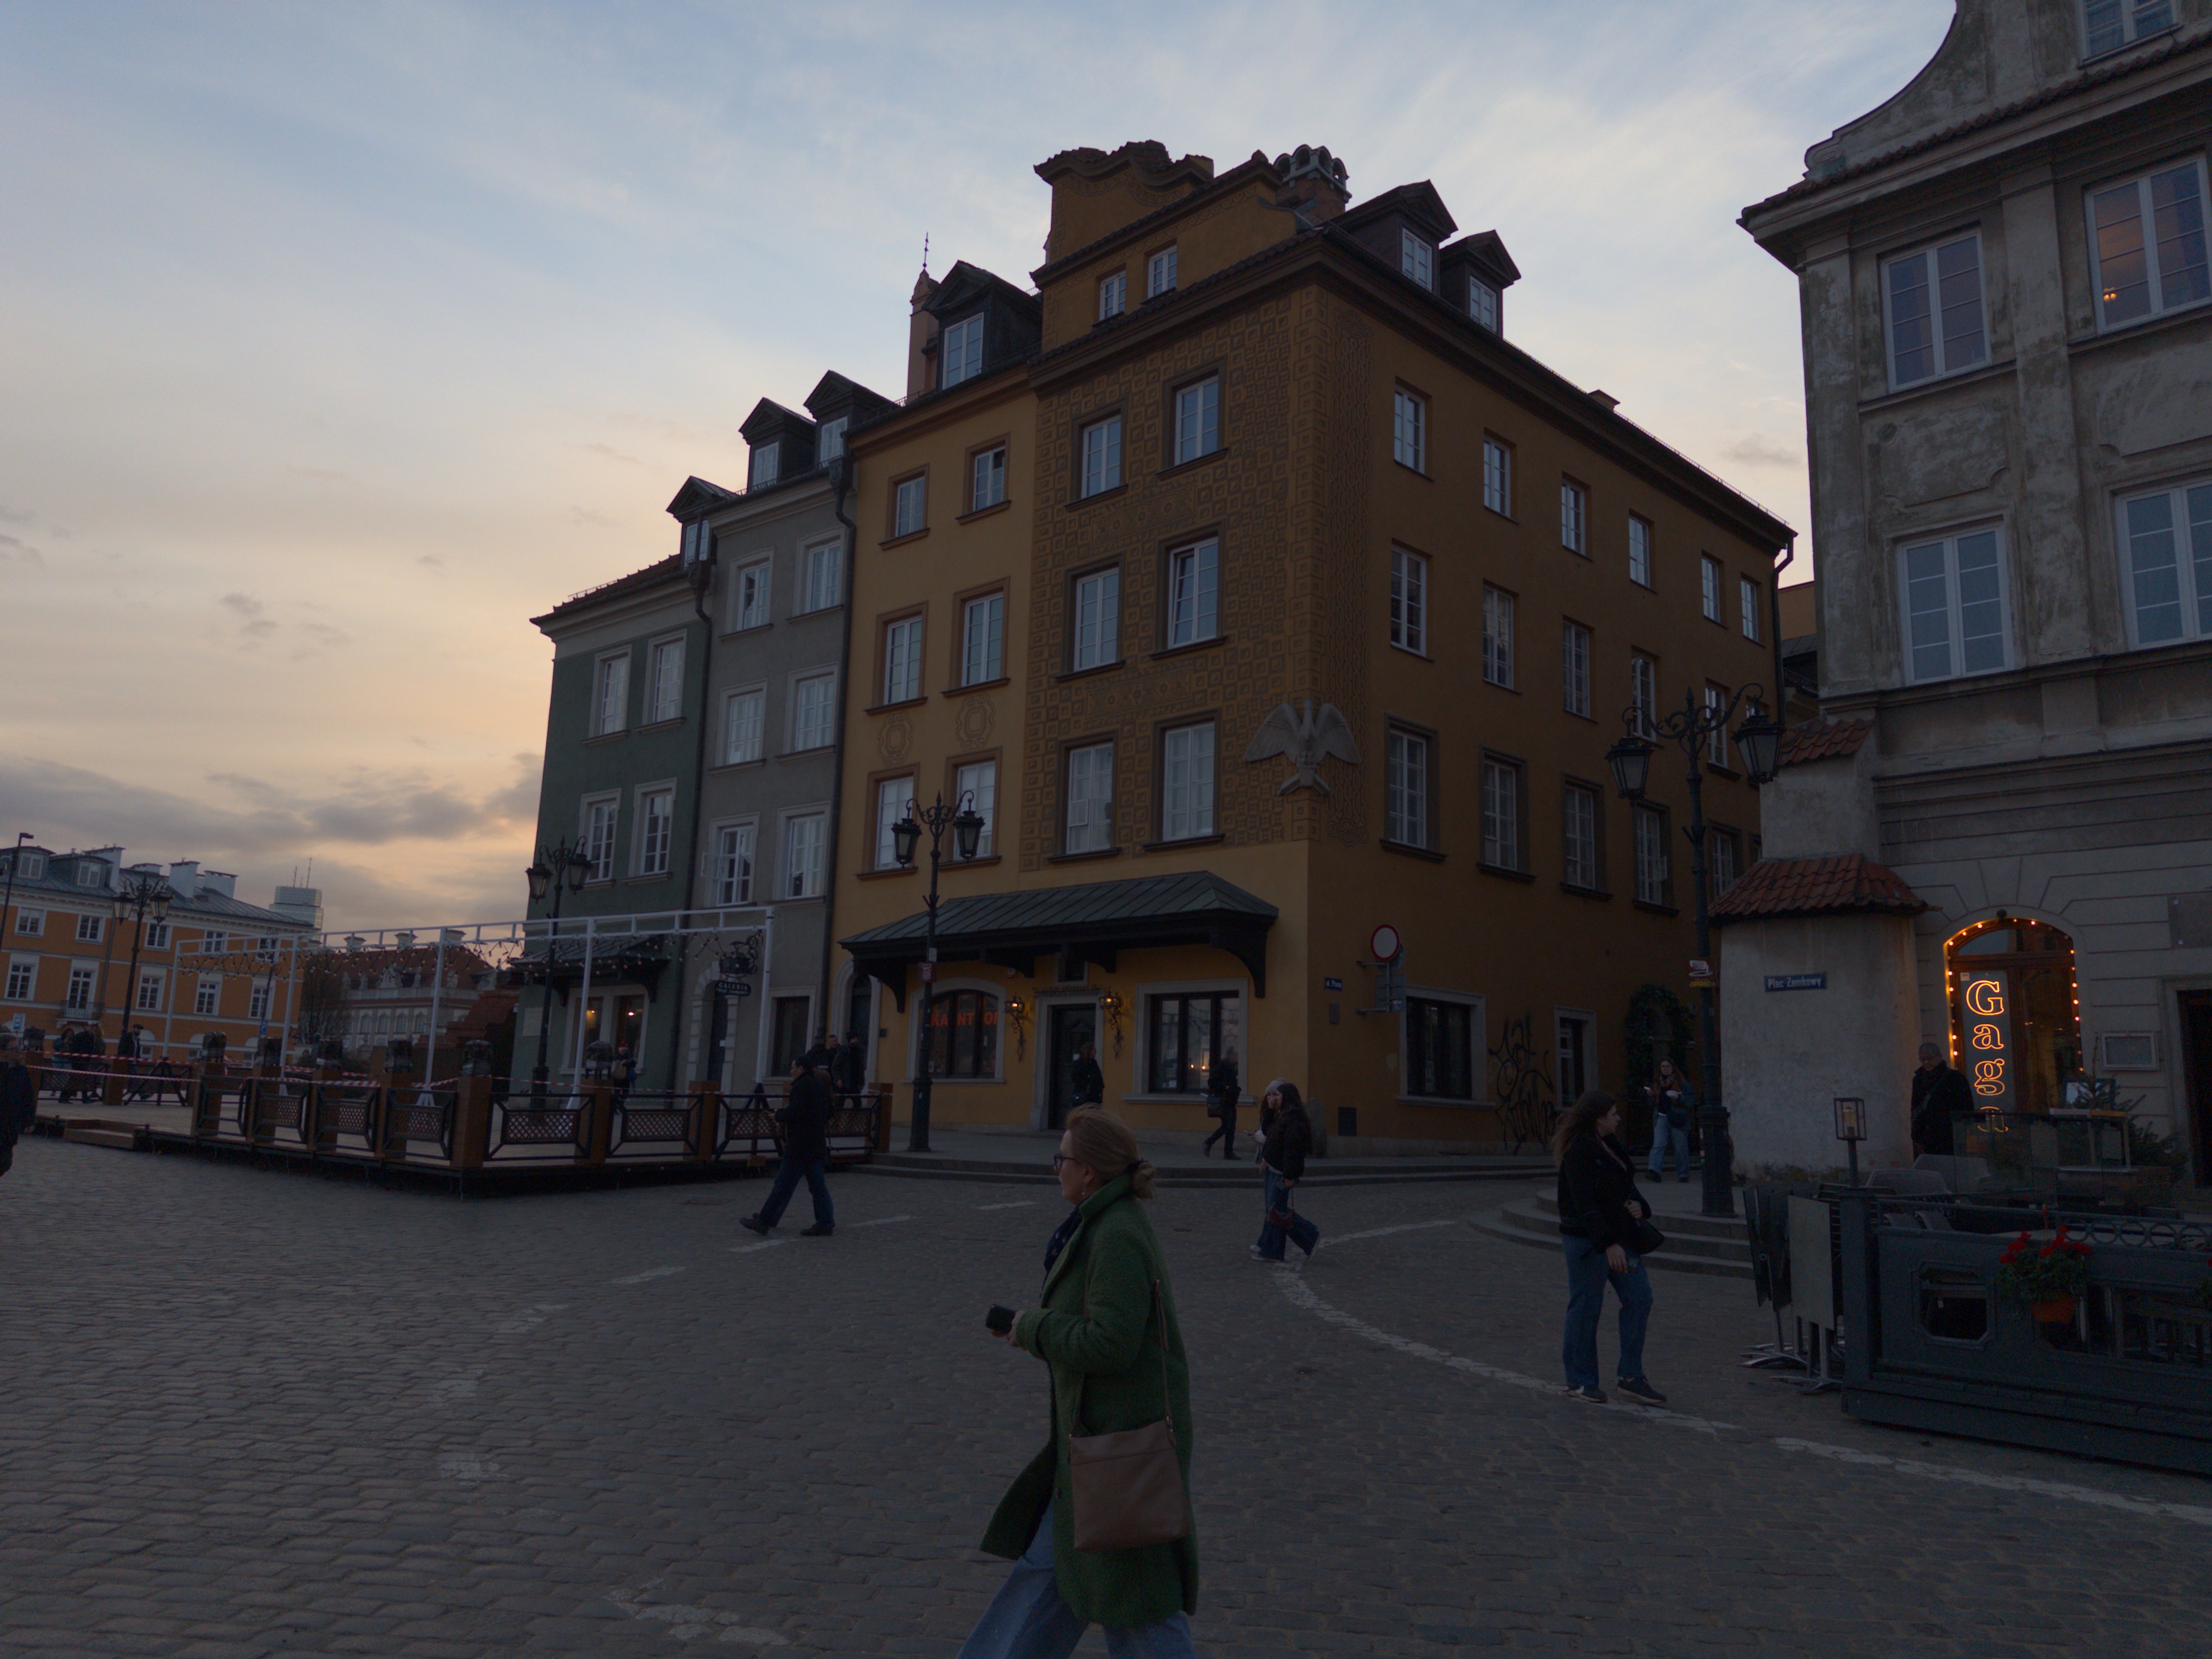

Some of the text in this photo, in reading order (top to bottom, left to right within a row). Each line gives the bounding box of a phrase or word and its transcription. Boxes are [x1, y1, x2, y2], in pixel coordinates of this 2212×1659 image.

[718, 981, 748, 991] GALERIA
[1768, 977, 1821, 989] Plac Zamkowy
